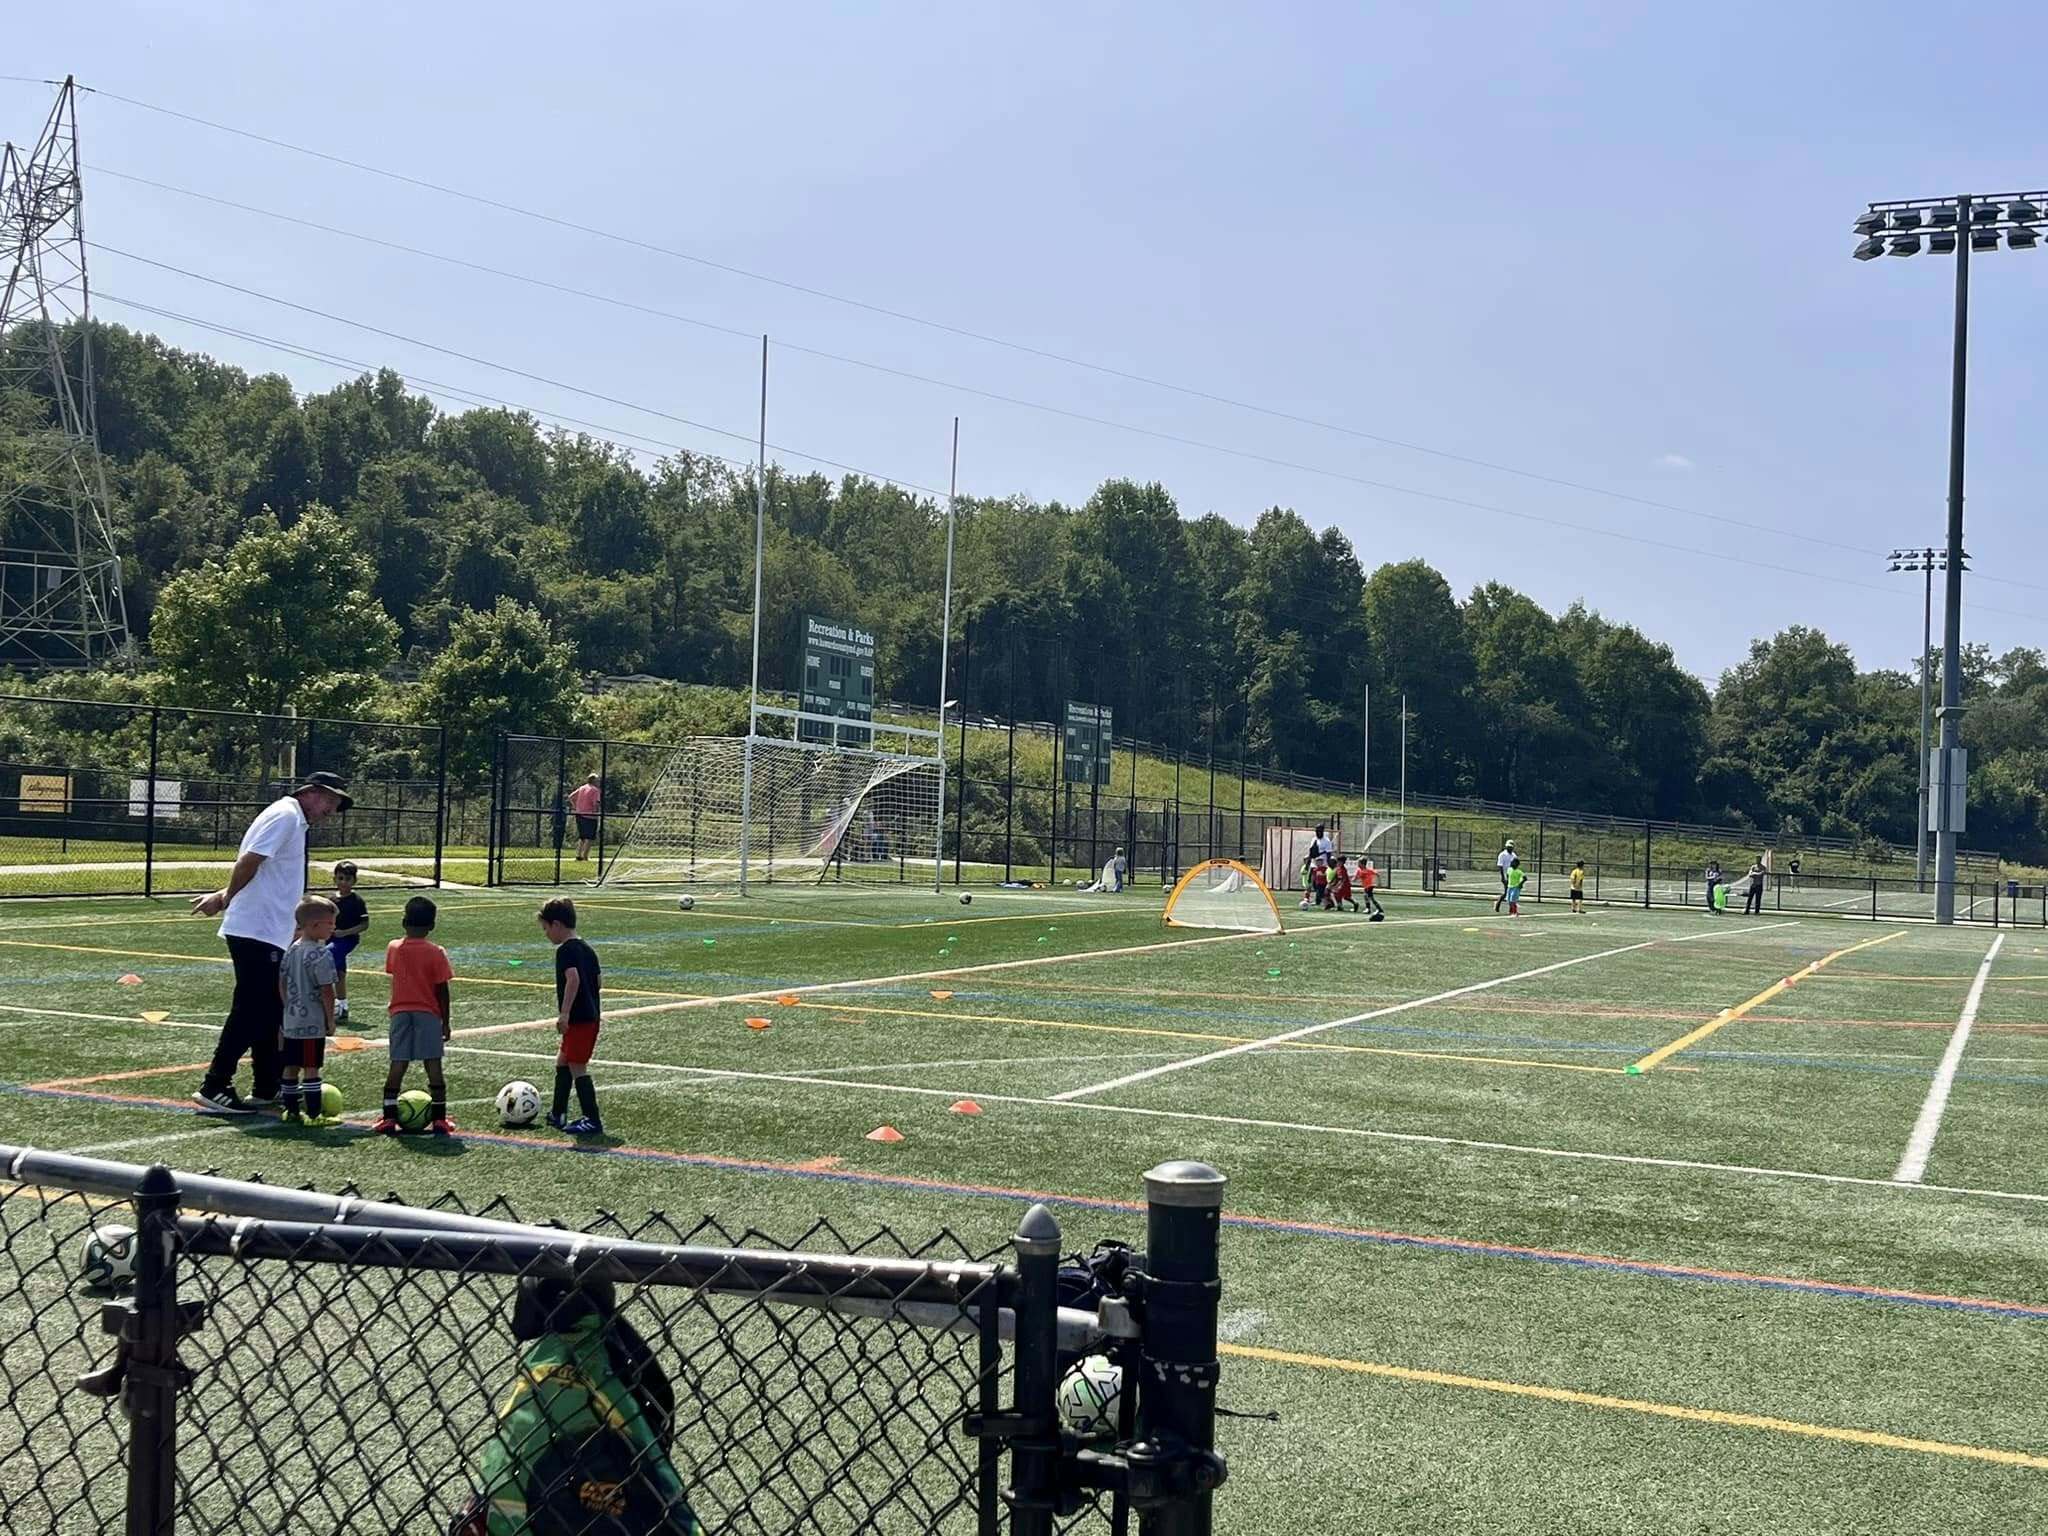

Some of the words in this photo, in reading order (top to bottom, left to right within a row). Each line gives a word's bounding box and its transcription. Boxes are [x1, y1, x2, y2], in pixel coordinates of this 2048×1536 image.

[808, 619, 847, 640] Recreation
[848, 628, 854, 641] &
[855, 630, 874, 645] Parks
